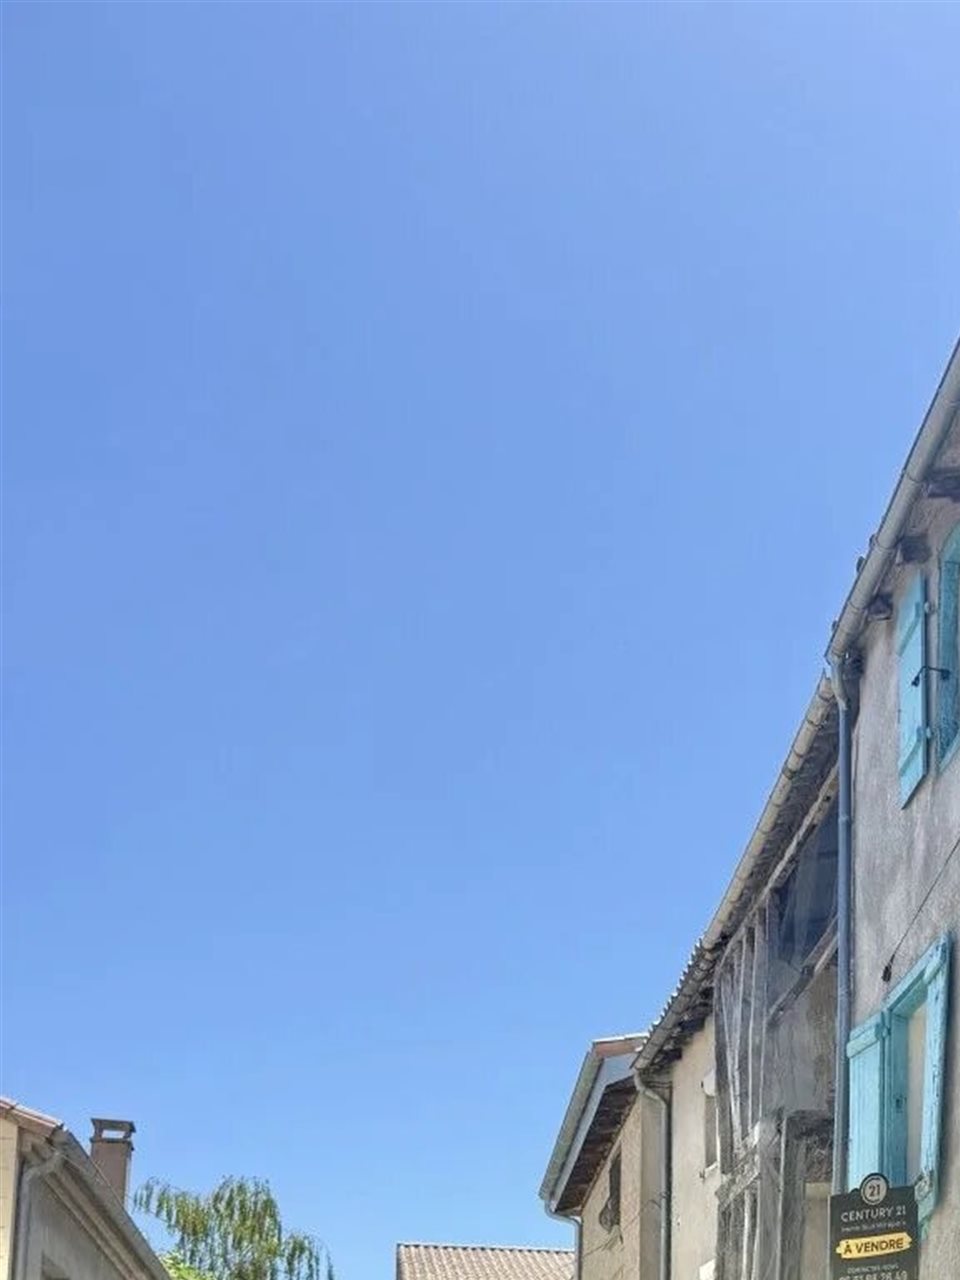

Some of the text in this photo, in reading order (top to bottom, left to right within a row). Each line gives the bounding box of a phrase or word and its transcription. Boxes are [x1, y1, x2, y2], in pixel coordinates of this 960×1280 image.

[868, 1184, 881, 1198] 21
[841, 1205, 907, 1222] CENTURY 21
[843, 1238, 904, 1255] À VENDRE
